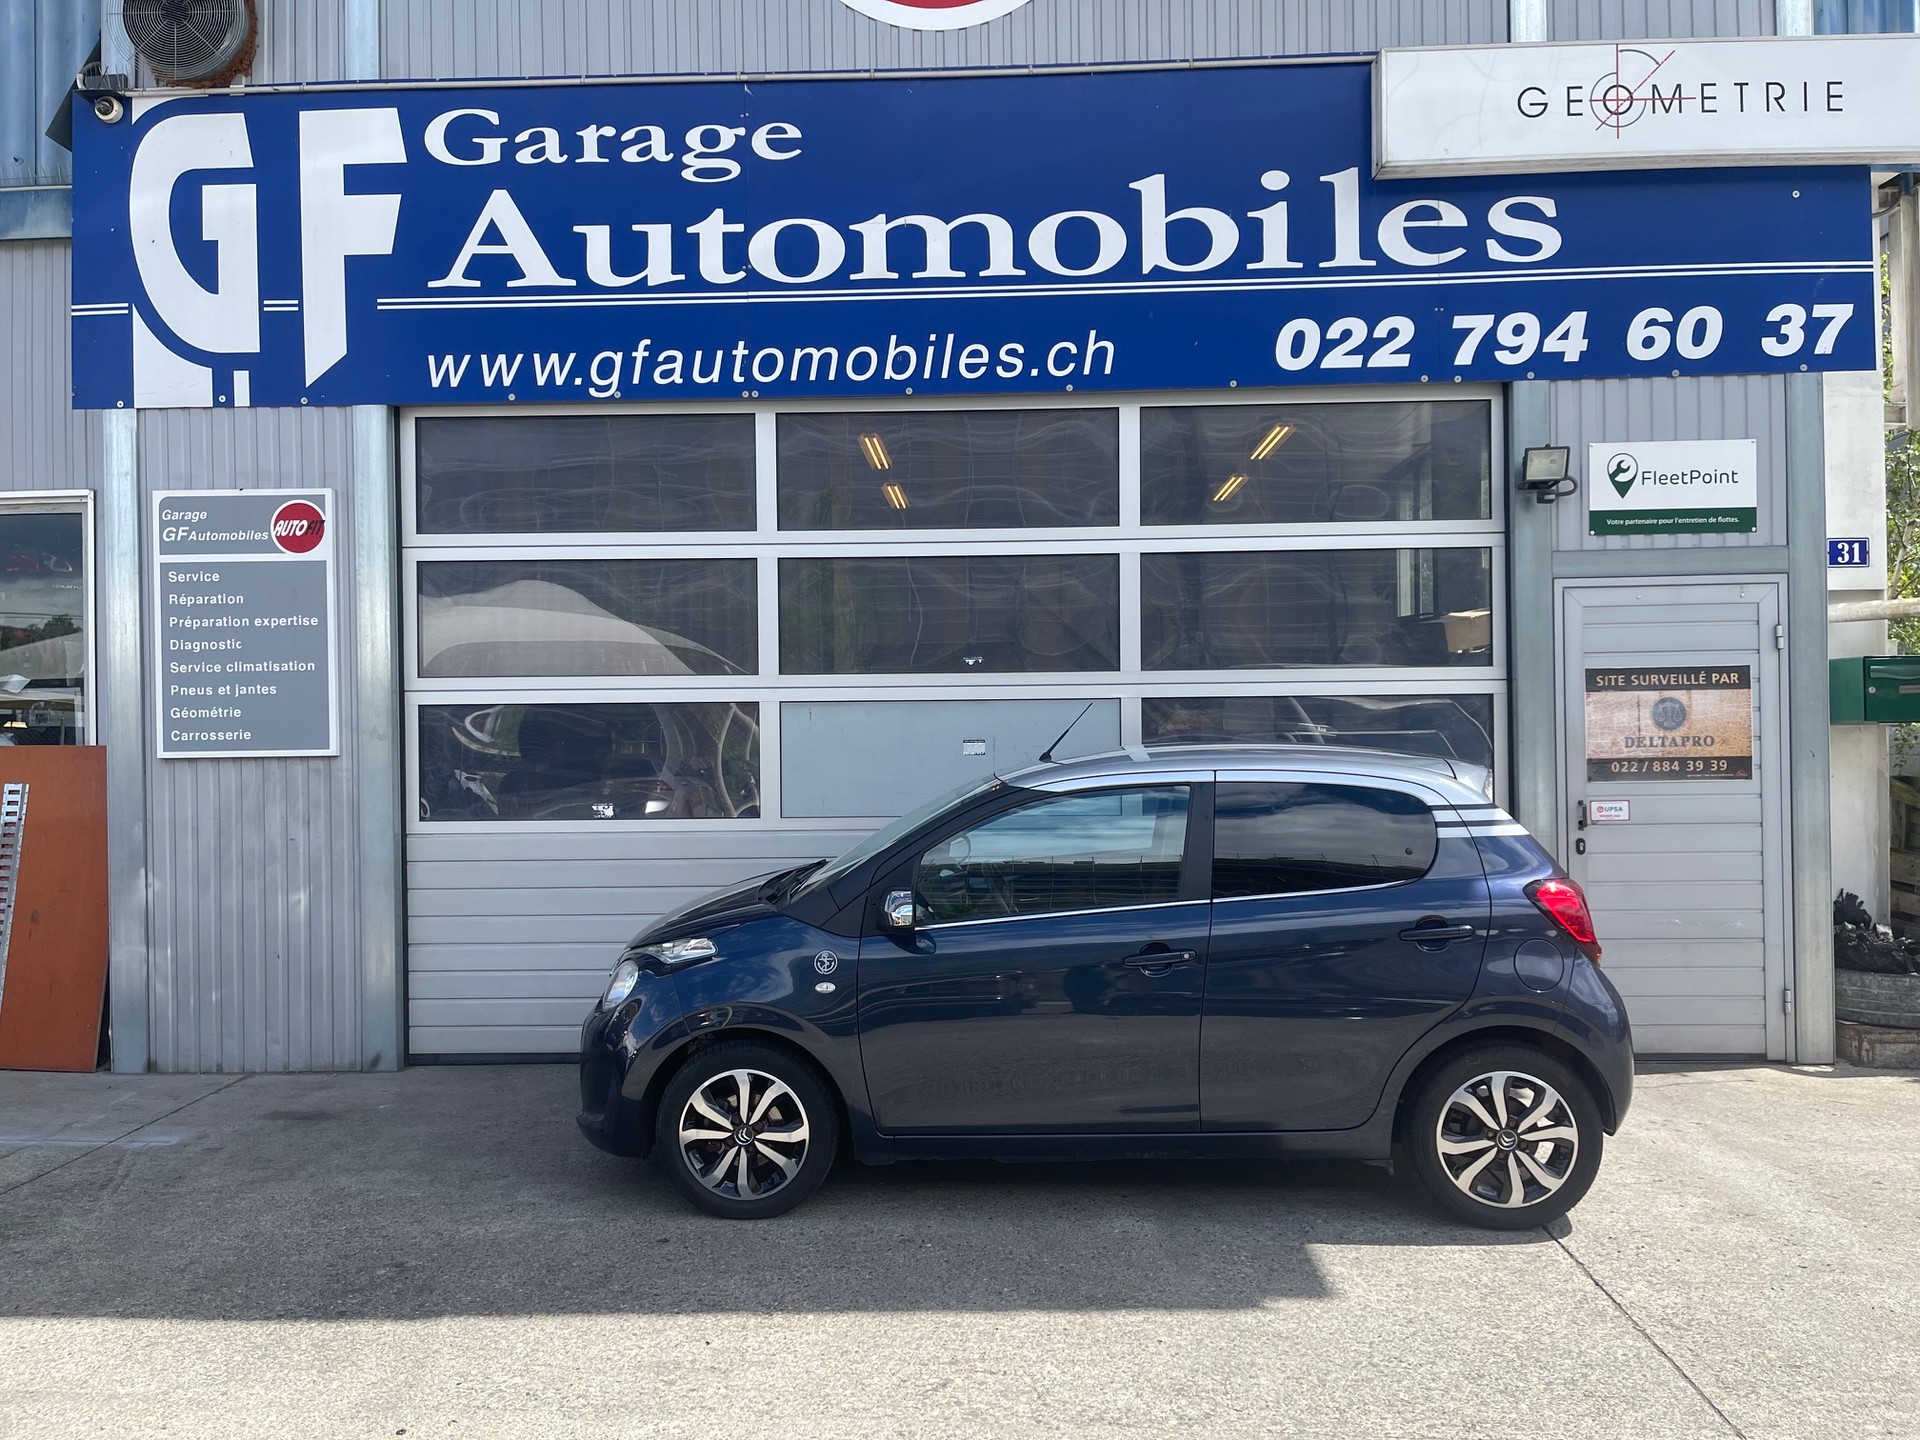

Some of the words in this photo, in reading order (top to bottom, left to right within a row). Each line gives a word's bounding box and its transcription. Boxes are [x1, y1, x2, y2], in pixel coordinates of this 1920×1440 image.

[1517, 81, 1843, 118] GEOMETRIE
[424, 108, 802, 183] Garage
[427, 166, 1563, 289] Automobiles
[129, 107, 408, 388] GF
[1275, 314, 1416, 372] 022
[1452, 310, 1590, 366] 794
[1626, 305, 1724, 361] 60
[1760, 303, 1855, 358] 37
[427, 329, 1117, 398] www.gfautomobiles.ch
[1641, 469, 1739, 486] FleetPoint
[161, 509, 208, 523] Garage
[1624, 518, 1658, 527] partenaire
[1658, 518, 1675, 526] pour
[1836, 542, 1862, 564] 31
[168, 571, 220, 582] Service
[168, 593, 244, 607] Réparation
[169, 616, 250, 630] Préparation
[254, 615, 319, 628] expertise
[169, 639, 243, 653] Diagnostic
[170, 661, 222, 673] Service
[226, 660, 316, 672] climatisation
[1596, 675, 1626, 687] SITE
[1630, 671, 1706, 686] SURVEILLÉ
[1711, 672, 1739, 685] PAR
[170, 685, 213, 695] Pneus
[217, 684, 231, 695] et
[234, 684, 278, 697] jantes
[170, 706, 242, 718] Géométrie
[170, 729, 252, 741] Carrosserie
[1624, 735, 1715, 748] DELTAPRO
[1611, 762, 1638, 772] 022
[1652, 761, 1680, 771] 884
[1686, 760, 1704, 771] 39
[1710, 760, 1728, 771] 39
